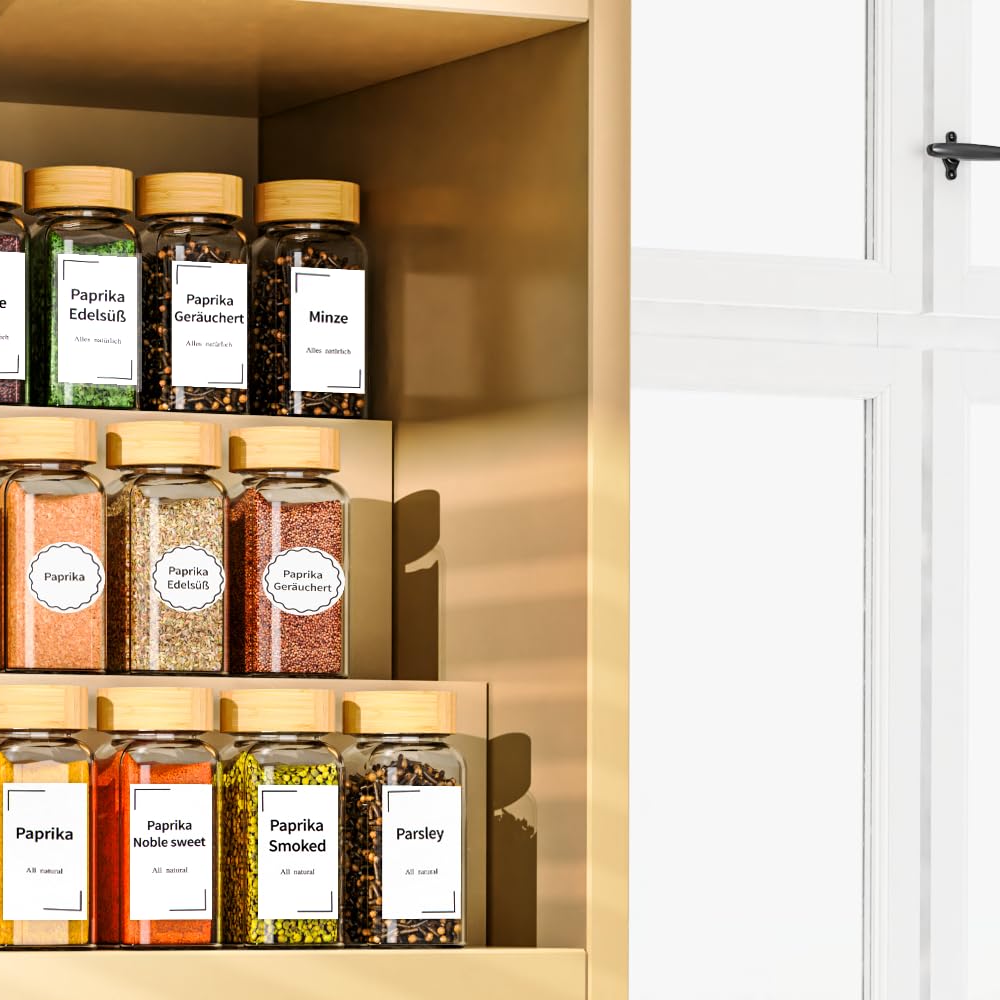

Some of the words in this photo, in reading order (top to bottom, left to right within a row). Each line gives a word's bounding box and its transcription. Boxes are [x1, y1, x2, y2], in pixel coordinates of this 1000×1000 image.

[71, 289, 124, 304] Paprika
[187, 294, 233, 308] Paprika
[70, 308, 126, 322] Edelsüß
[175, 311, 244, 324] Geräuchert
[310, 311, 348, 324] Minze
[185, 339, 203, 347] Alles
[169, 566, 208, 577] Paprika
[284, 570, 322, 580] Paprika
[45, 572, 85, 583] Paprika
[168, 580, 209, 590] Edelsüß
[274, 582, 332, 593] Geräuchert
[148, 820, 192, 833] Paprika
[271, 818, 323, 835] Paprika
[16, 827, 73, 843] Paprika
[397, 826, 444, 842] Parsley
[134, 837, 168, 847] Noble
[171, 837, 206, 847] sweet
[269, 839, 326, 852] Smoked
[39, 867, 64, 875] natural
[151, 866, 163, 874] All
[165, 866, 188, 874] natural
[280, 868, 291, 876] All
[293, 868, 315, 876] natural
[404, 868, 415, 876] All
[417, 867, 439, 875] natural
